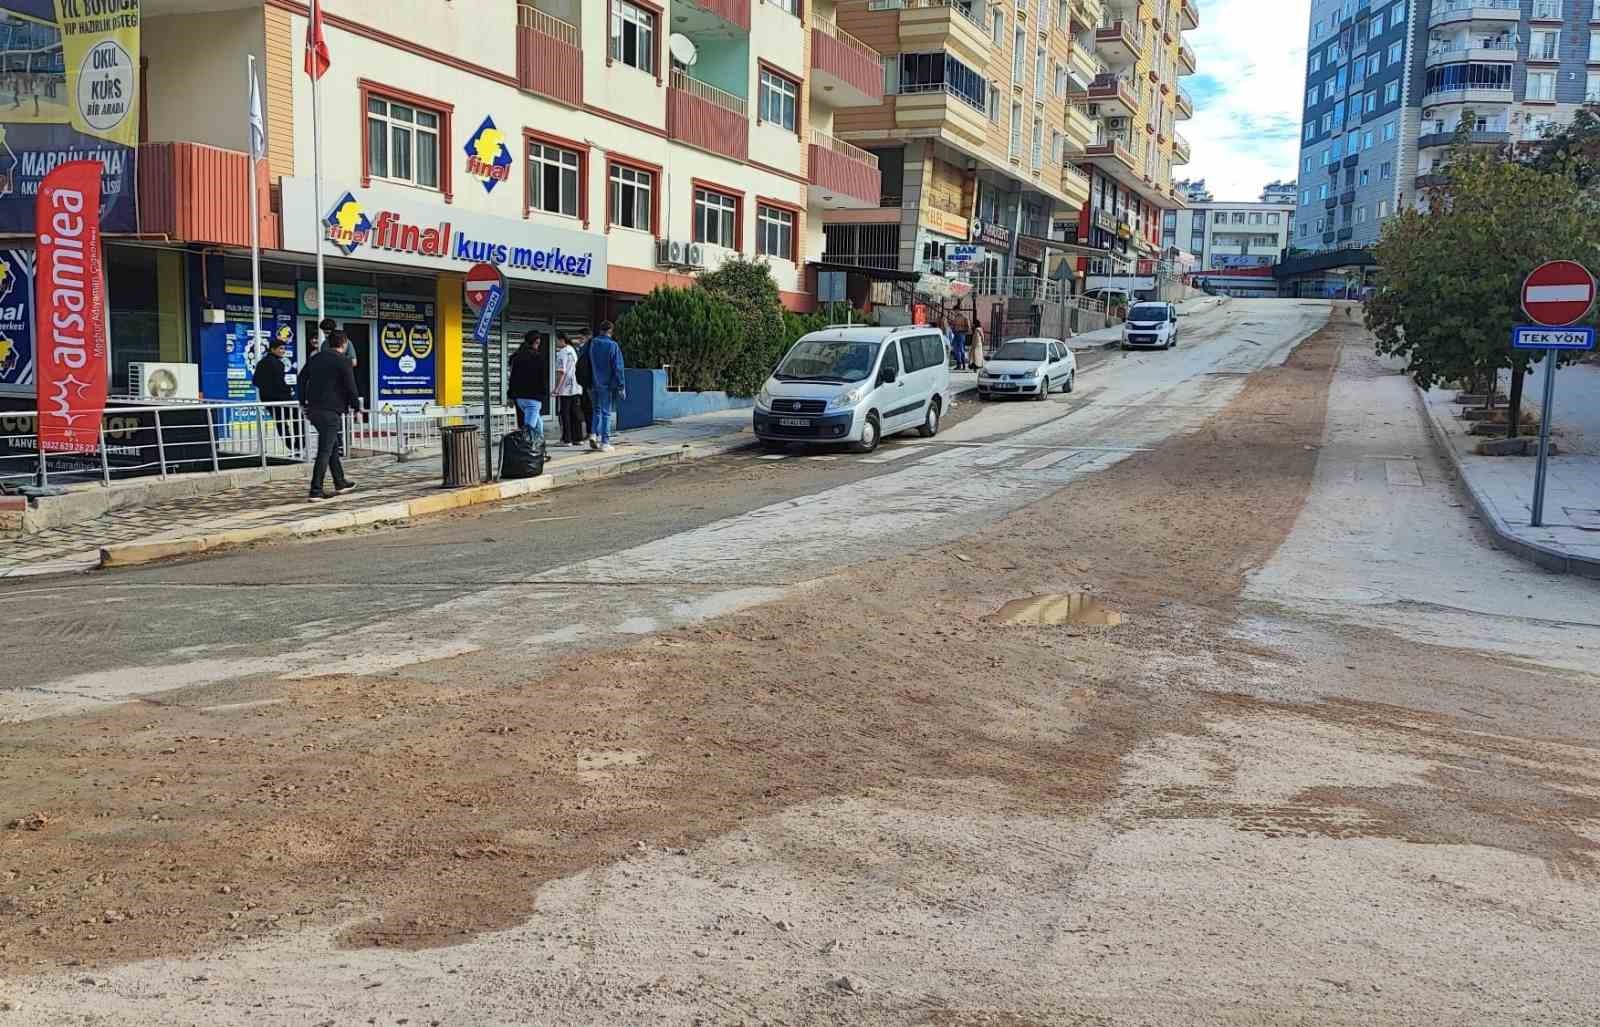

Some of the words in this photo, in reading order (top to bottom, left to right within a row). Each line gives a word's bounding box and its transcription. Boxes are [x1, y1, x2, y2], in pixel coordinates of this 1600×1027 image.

[92, 48, 119, 70] OKUL
[91, 79, 122, 101] KURS
[376, 210, 452, 256] final
[457, 231, 508, 263] kurs
[513, 247, 593, 276] merkezi
[40, 188, 85, 369] arsamiea
[1522, 333, 1550, 343] TEK
[1555, 332, 1585, 344] YÖN
[8, 436, 37, 450] KAHVE
